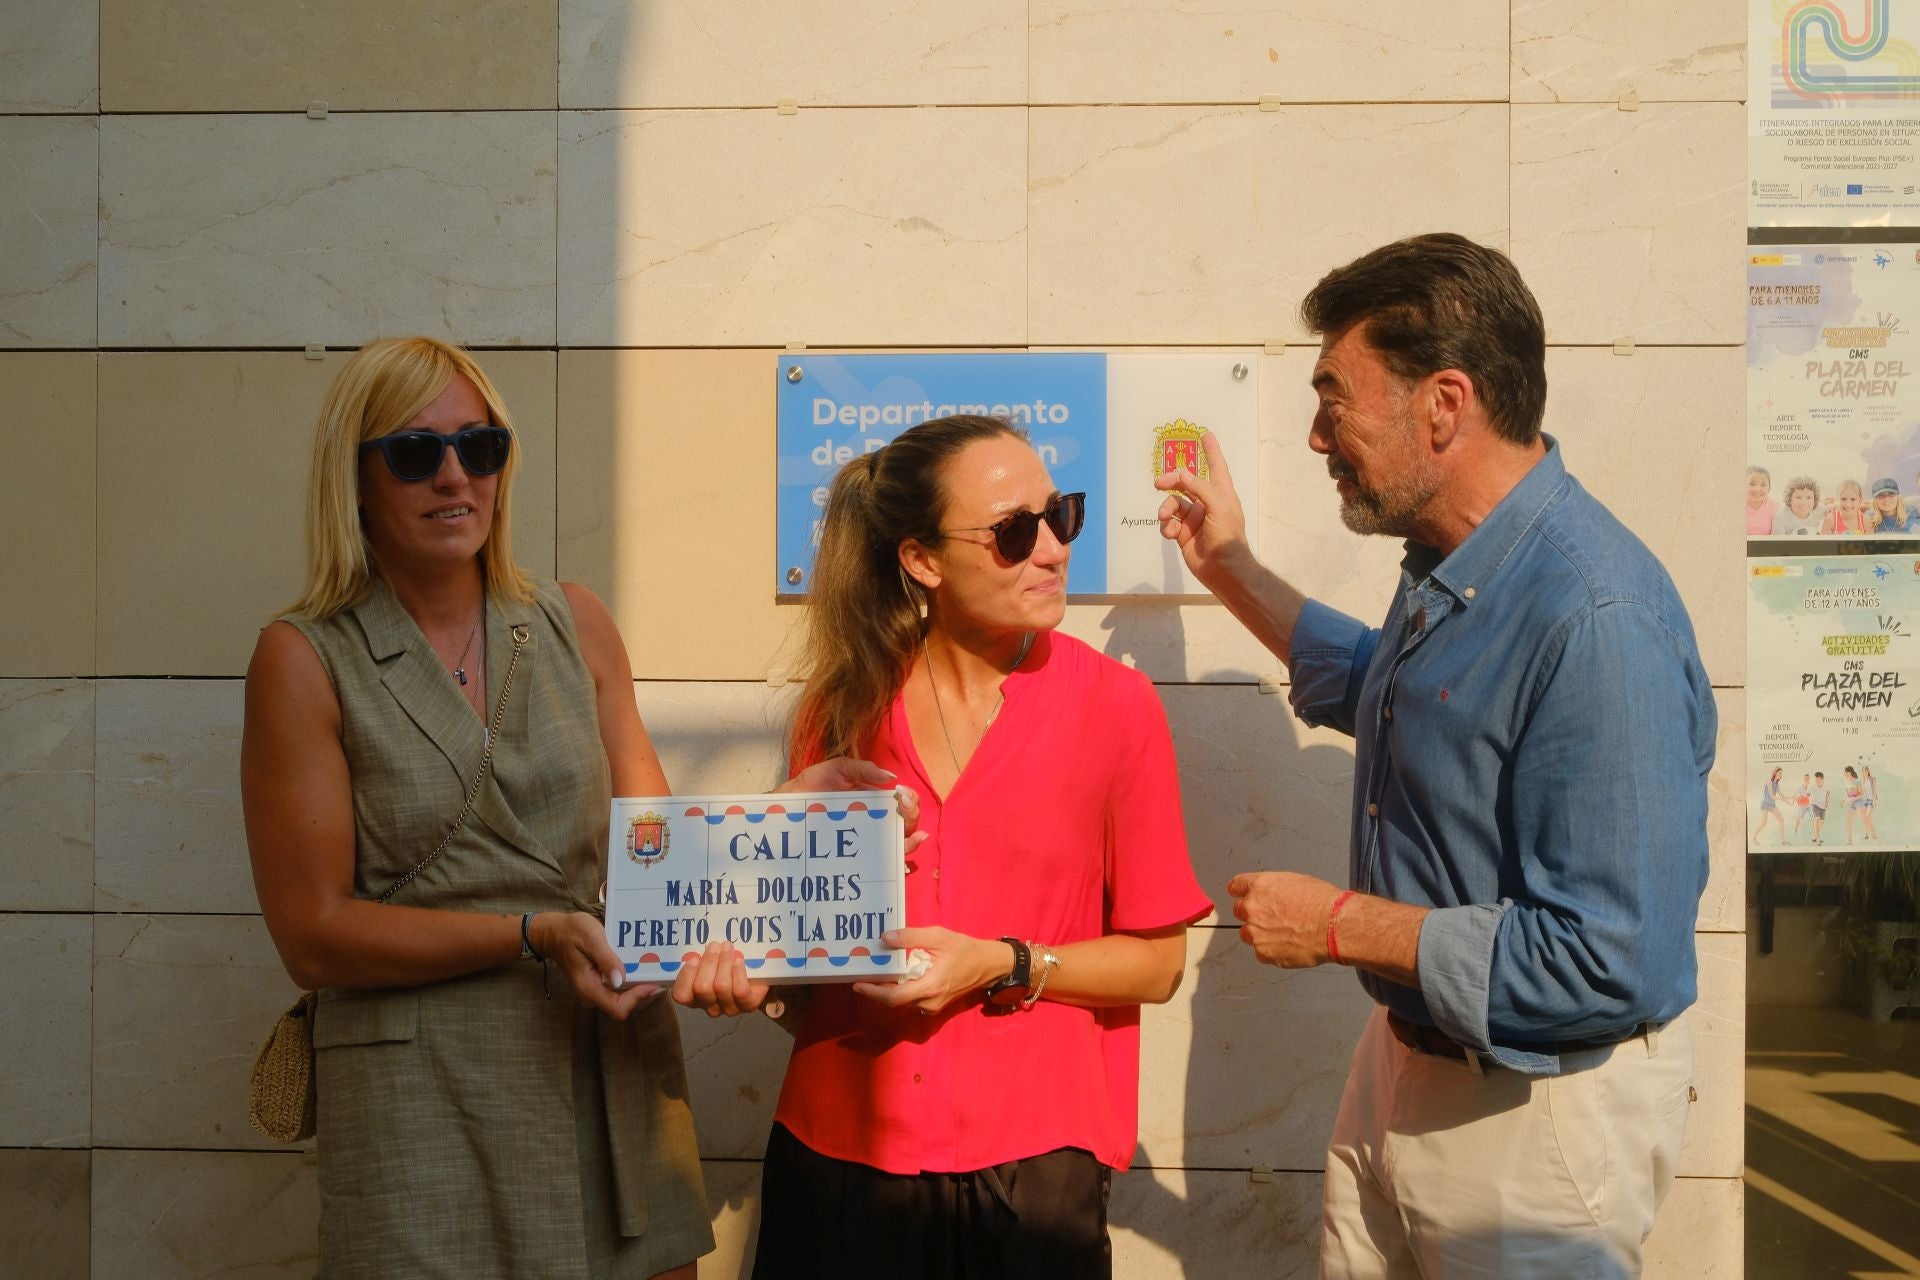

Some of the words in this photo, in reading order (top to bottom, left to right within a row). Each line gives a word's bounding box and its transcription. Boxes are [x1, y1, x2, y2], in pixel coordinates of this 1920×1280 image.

[1759, 119, 1809, 127] ITINERARIOS
[1811, 119, 1861, 127] INTEGRADOS
[1862, 119, 1883, 127] PARA
[1884, 119, 1894, 127] LA
[1765, 128, 1823, 137] SOCIOLABORAL
[1825, 128, 1836, 137] DE
[1837, 128, 1878, 137] PERSONAS
[1880, 128, 1890, 137] EN
[1787, 138, 1794, 146] O
[1796, 138, 1825, 146] RIESGO
[1827, 138, 1838, 146] DE
[1839, 137, 1882, 146] EXCLUSIÓN
[1884, 138, 1912, 146] SOCIAL
[1783, 155, 1812, 163] Programa
[1852, 155, 1877, 163] Europeo
[1749, 285, 1772, 295] PARA
[1774, 285, 1821, 295] MENORES
[1751, 296, 1764, 306] DE
[1767, 296, 1773, 305] 6
[1775, 296, 1782, 305] A
[1784, 296, 1793, 305] 11
[1848, 349, 1869, 359] CMS
[1806, 360, 1867, 379] PLAZA
[1873, 360, 1912, 378] DEL
[1819, 379, 1898, 400] CARMEN
[813, 398, 1070, 432] Departamento
[1762, 432, 1809, 440] TECNOLOGÍA
[812, 439, 854, 466] de
[1807, 588, 1831, 598] PARA
[1834, 586, 1876, 598] JÓVENES
[1804, 599, 1818, 609] DE
[1821, 599, 1831, 608] 12
[1833, 599, 1840, 608] A
[1843, 599, 1853, 608] 17
[1822, 635, 1890, 646] ACTIVIDADES
[1826, 645, 1886, 655] GRATUITAS
[1843, 660, 1864, 671] CMS
[1801, 672, 1863, 691] PLAZA
[1869, 672, 1907, 688] DEL
[1815, 691, 1893, 711] CARMEN
[1758, 741, 1805, 750] TECNOLOGÍA
[729, 827, 860, 862] CALLE
[665, 872, 740, 907] MARÍA
[757, 873, 862, 904] DOLORES
[617, 912, 710, 948] PERETÓ
[725, 915, 782, 944] COTS
[789, 910, 826, 943] "LA
[834, 906, 894, 941] BOTI"
